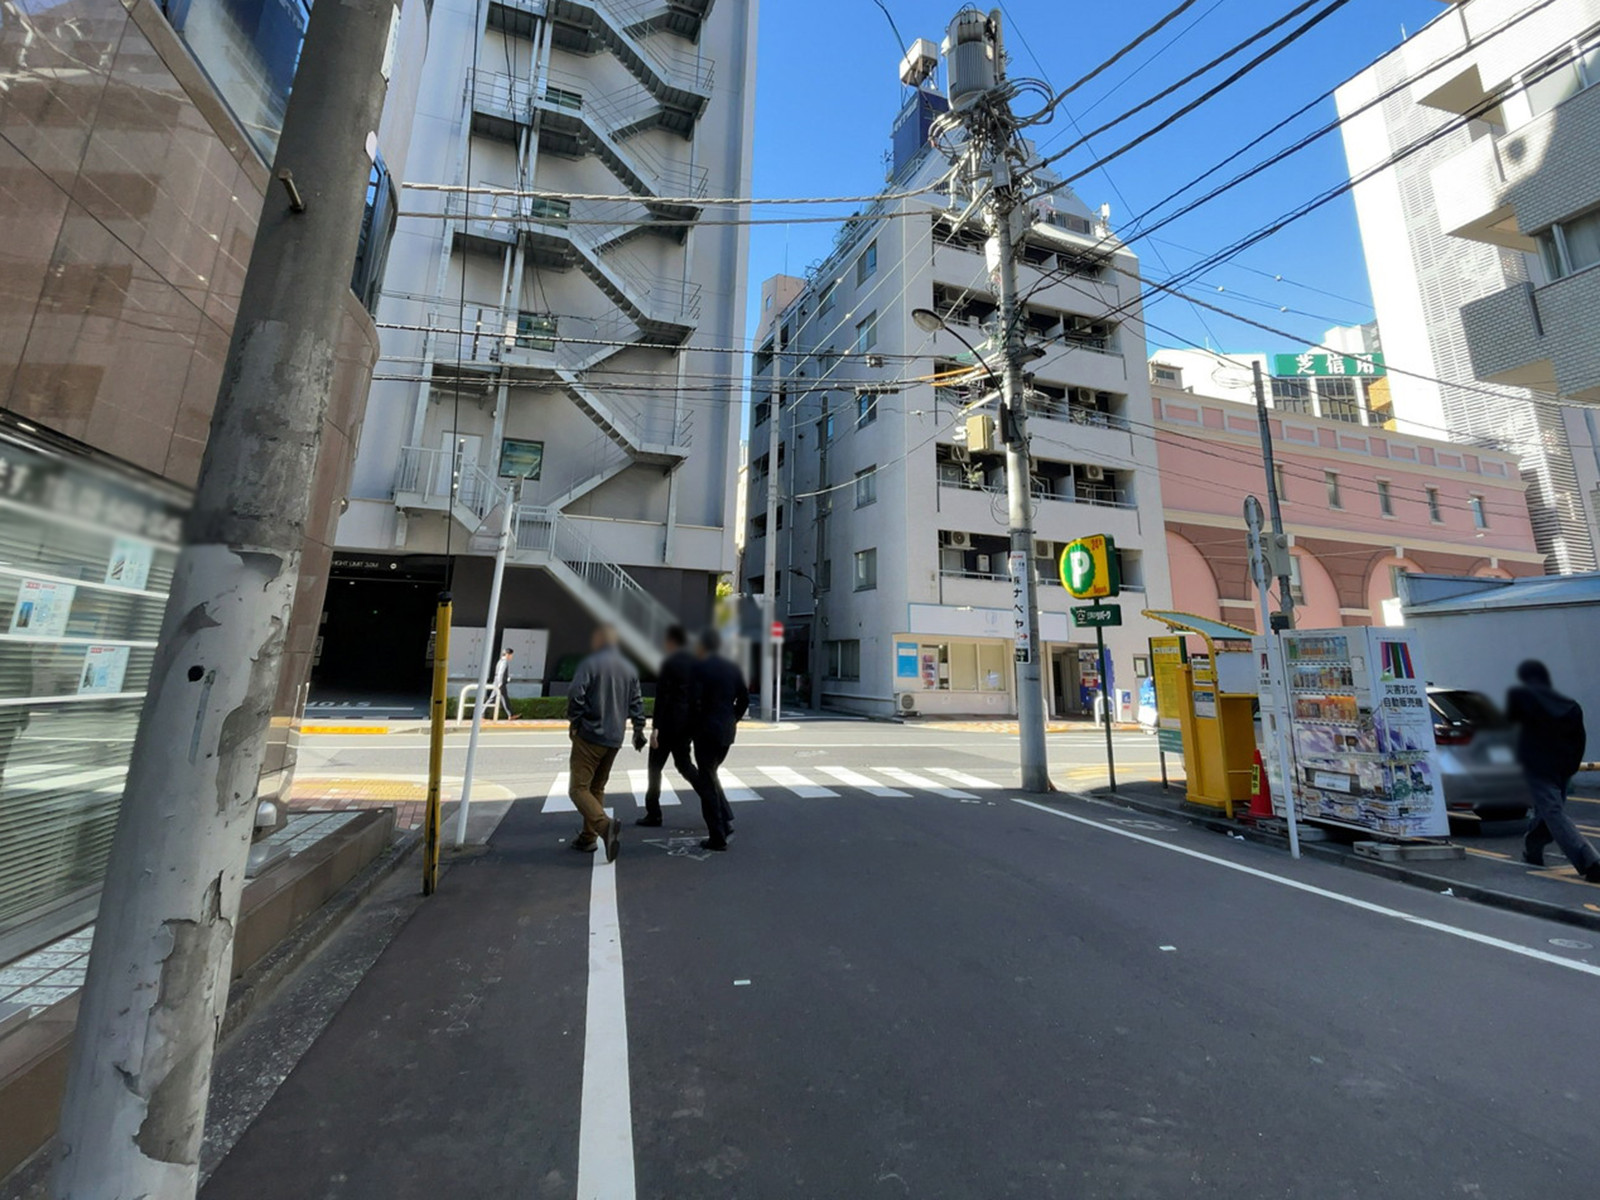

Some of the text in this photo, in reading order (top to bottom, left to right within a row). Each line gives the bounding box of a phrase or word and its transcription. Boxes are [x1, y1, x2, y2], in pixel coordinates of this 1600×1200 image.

[1295, 353, 1375, 375] 芝信用
[1070, 551, 1091, 589] P
[1385, 684, 1418, 695] 災害対応
[1383, 697, 1424, 707] 自動販売機
